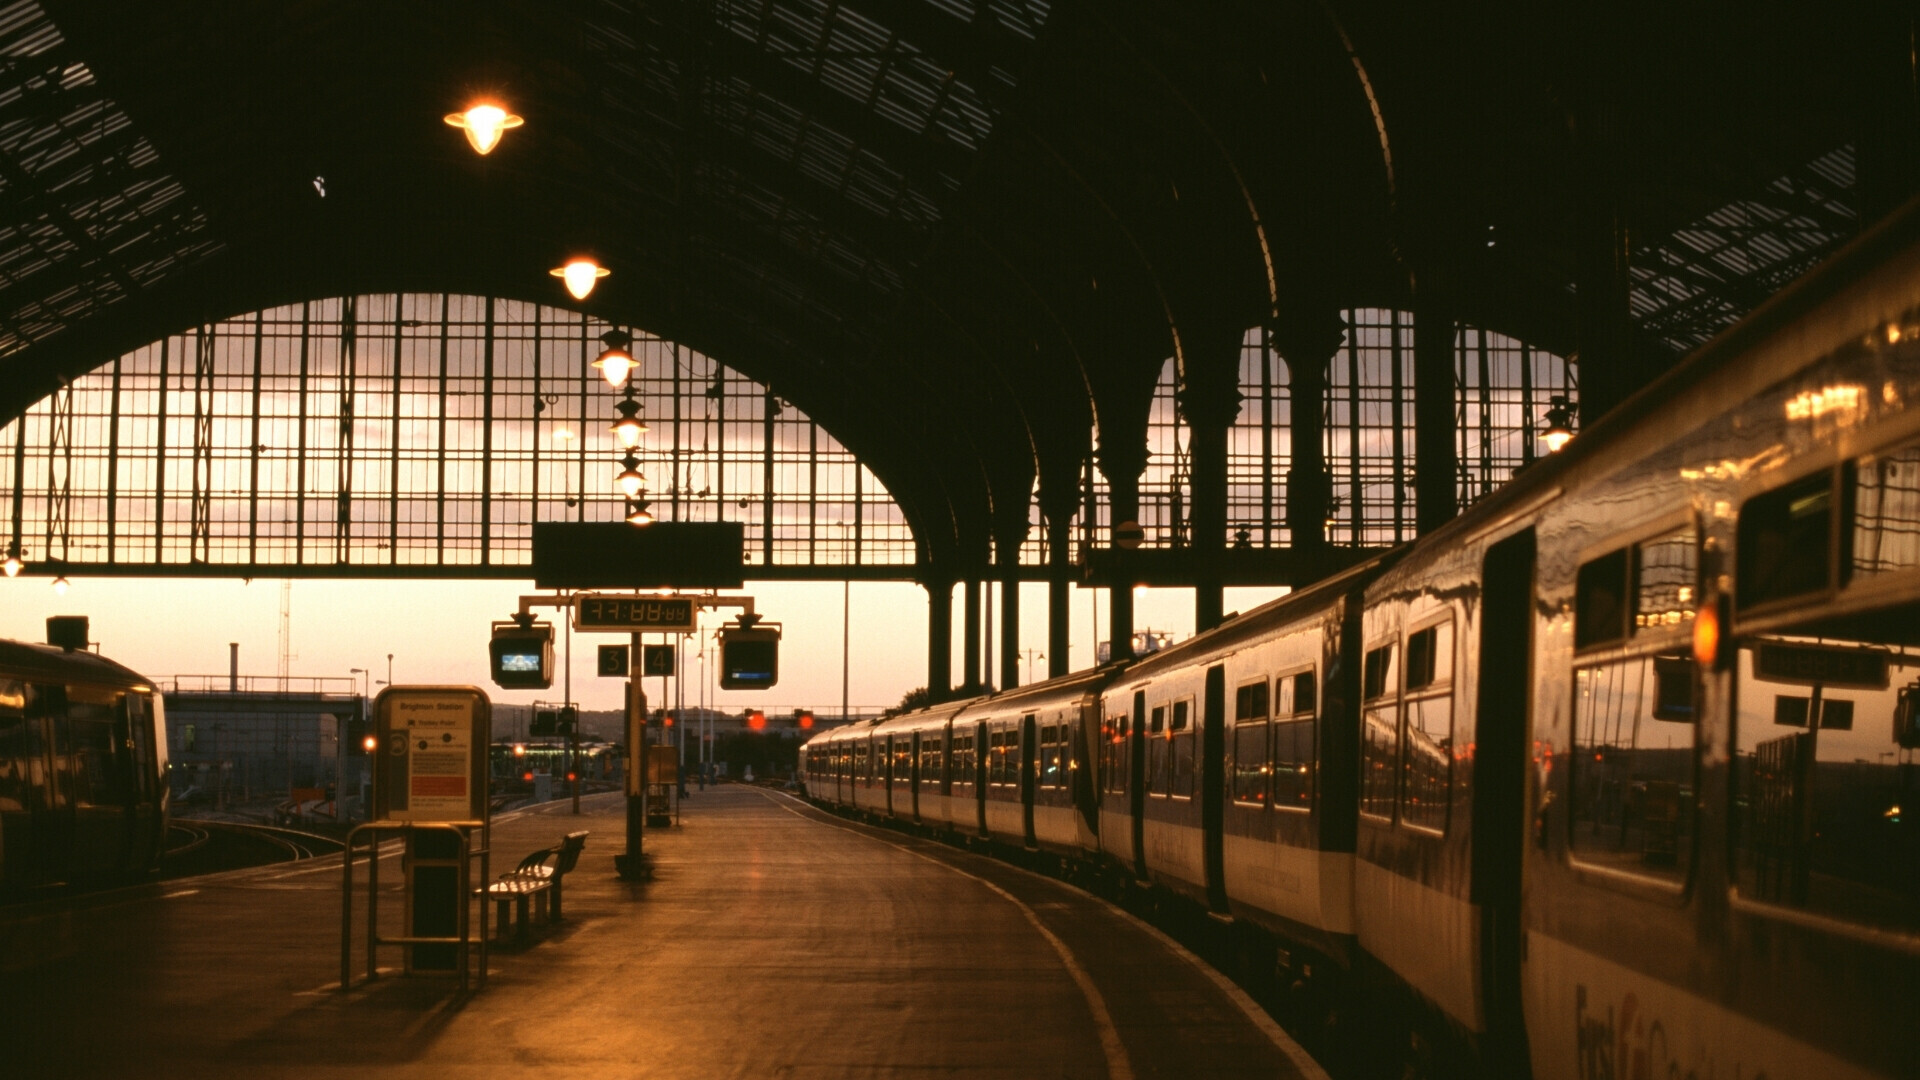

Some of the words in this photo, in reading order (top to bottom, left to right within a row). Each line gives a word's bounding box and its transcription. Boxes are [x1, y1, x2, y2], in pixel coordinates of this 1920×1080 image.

[607, 650, 620, 672] 3
[652, 650, 667, 672] 4
[401, 703, 434, 712] Brighton
[437, 703, 464, 711] Station
